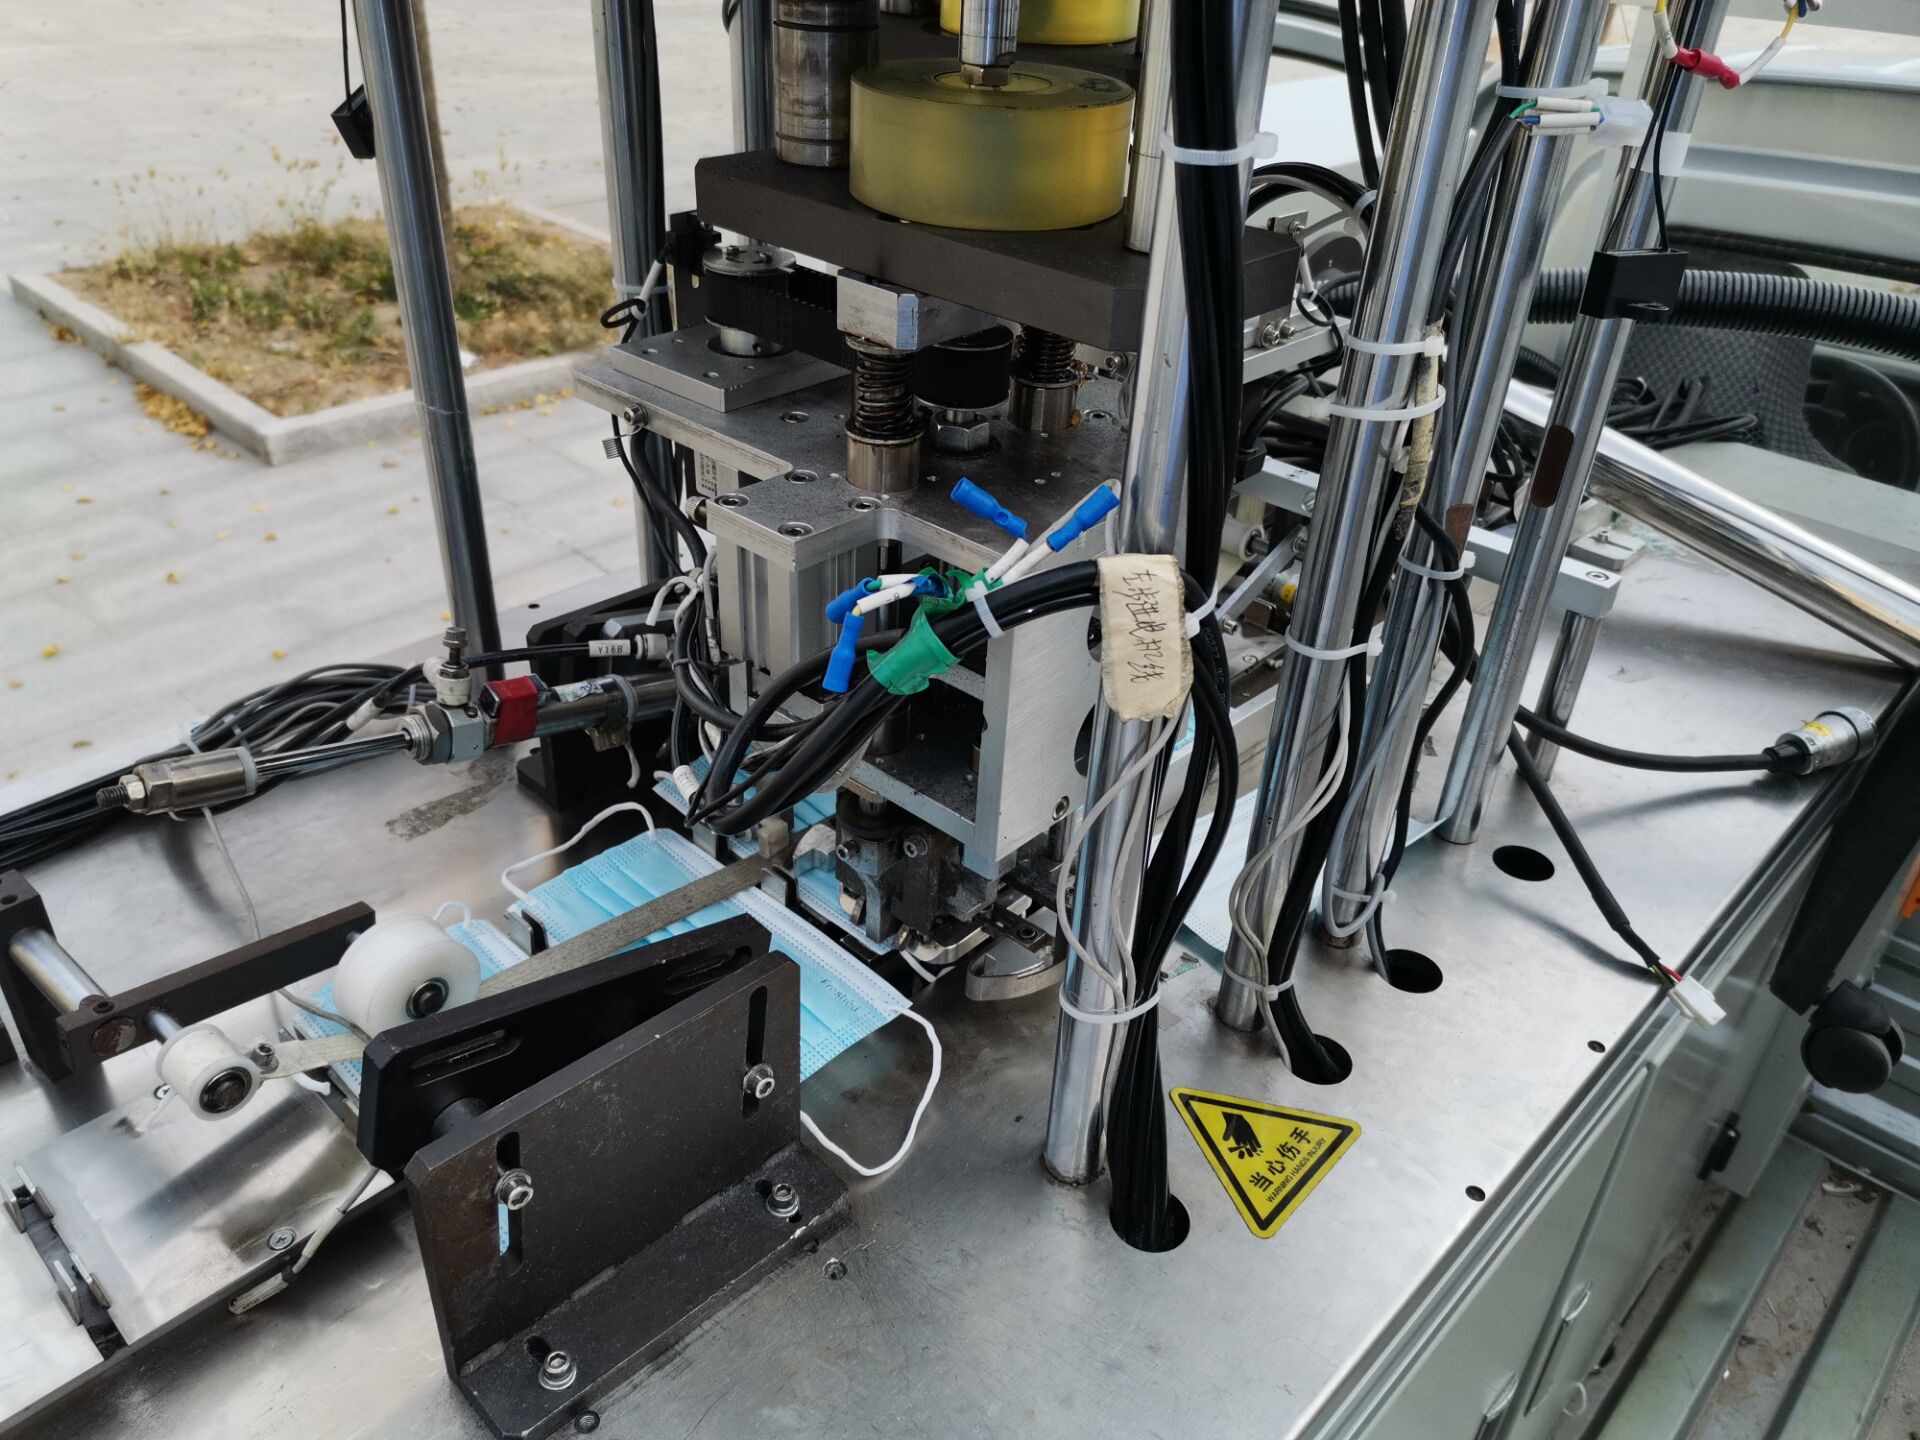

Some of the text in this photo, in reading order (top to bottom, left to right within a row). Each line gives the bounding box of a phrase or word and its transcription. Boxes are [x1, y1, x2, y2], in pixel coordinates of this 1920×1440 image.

[598, 646, 623, 655] Y16B
[1249, 1126, 1312, 1192] 当心伤手
[1265, 1136, 1327, 1203] WARNING HANDS INJURY
